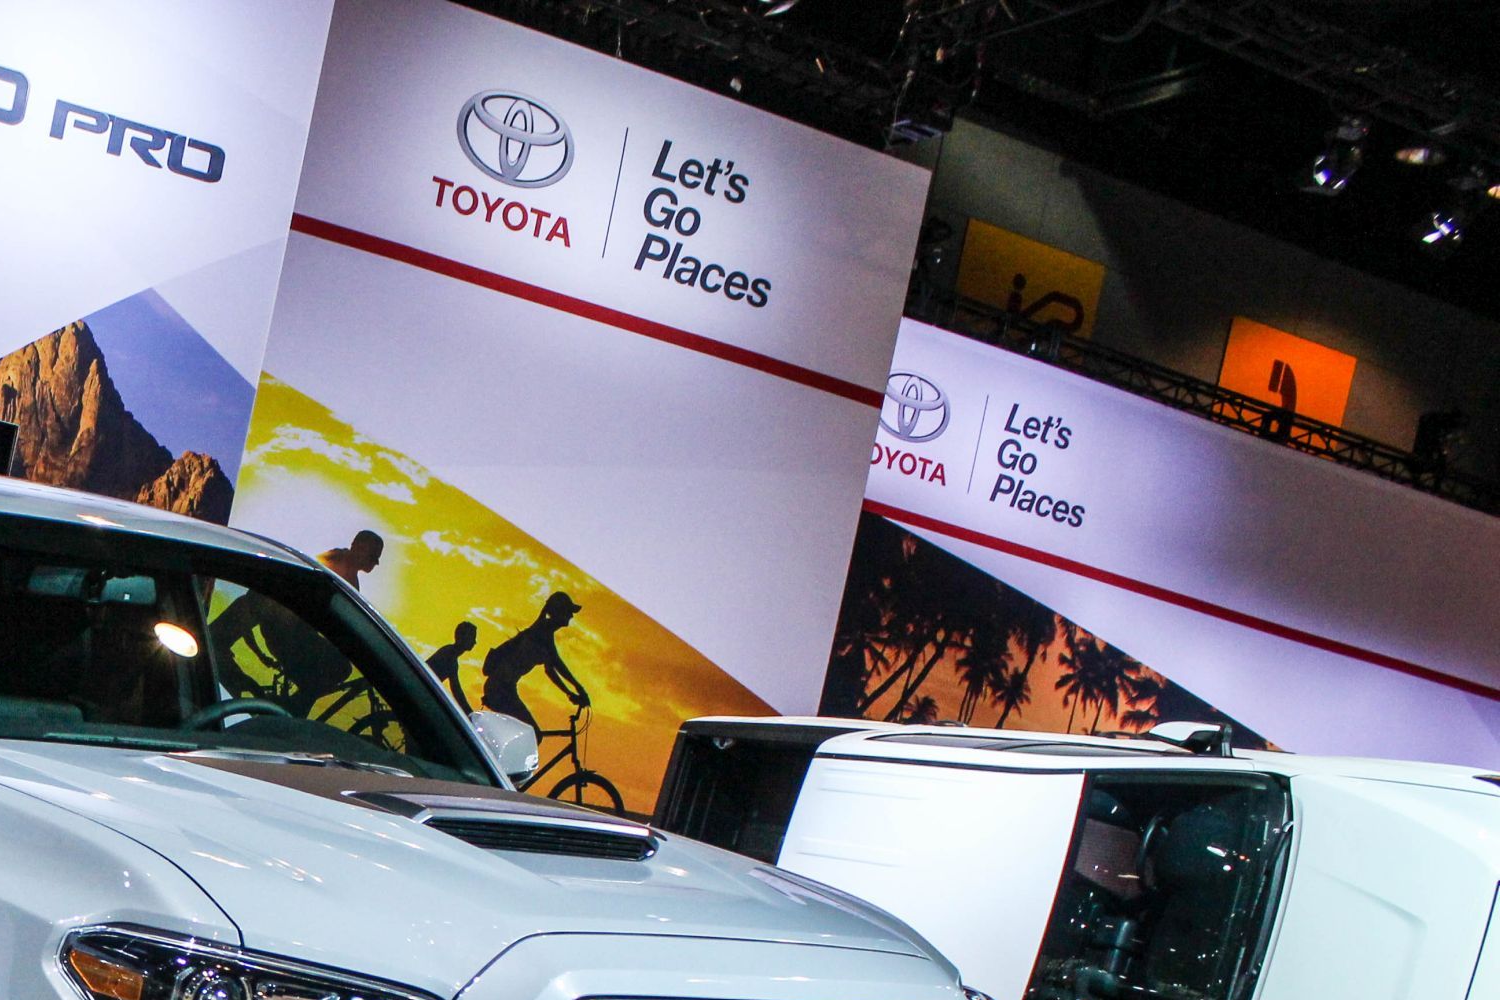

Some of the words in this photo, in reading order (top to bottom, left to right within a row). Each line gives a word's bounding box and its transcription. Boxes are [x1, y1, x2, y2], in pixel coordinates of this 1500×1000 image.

[49, 99, 226, 183] PRO
[651, 140, 750, 204] Let's
[431, 175, 572, 248] TOYOTA
[643, 186, 702, 237] Go
[633, 232, 772, 308] Places
[1003, 402, 1073, 450] Let's
[870, 442, 947, 487] OYOTA
[996, 438, 1038, 476] Go
[988, 473, 1086, 528] Places
